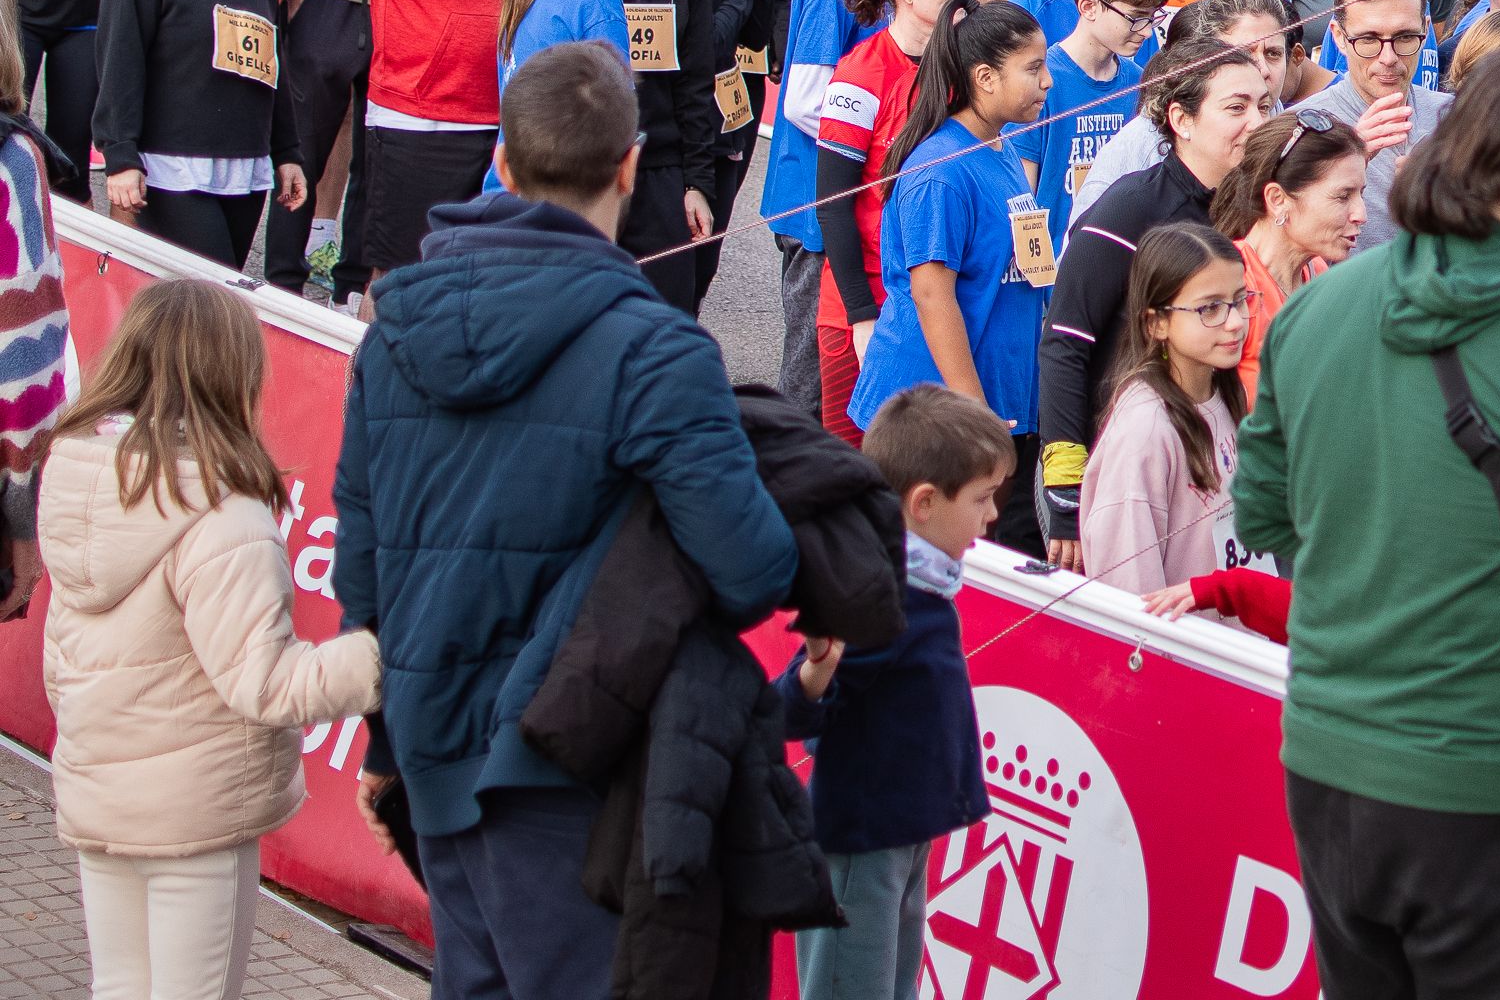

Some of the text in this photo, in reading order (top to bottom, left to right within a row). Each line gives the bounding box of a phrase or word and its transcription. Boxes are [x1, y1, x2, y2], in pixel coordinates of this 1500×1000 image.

[242, 35, 260, 54] 61
[631, 28, 654, 44] 49
[227, 51, 271, 75] GISELLE
[828, 94, 861, 113] UCSC
[1076, 114, 1124, 133] INSTITUT
[1028, 237, 1041, 257] 95
